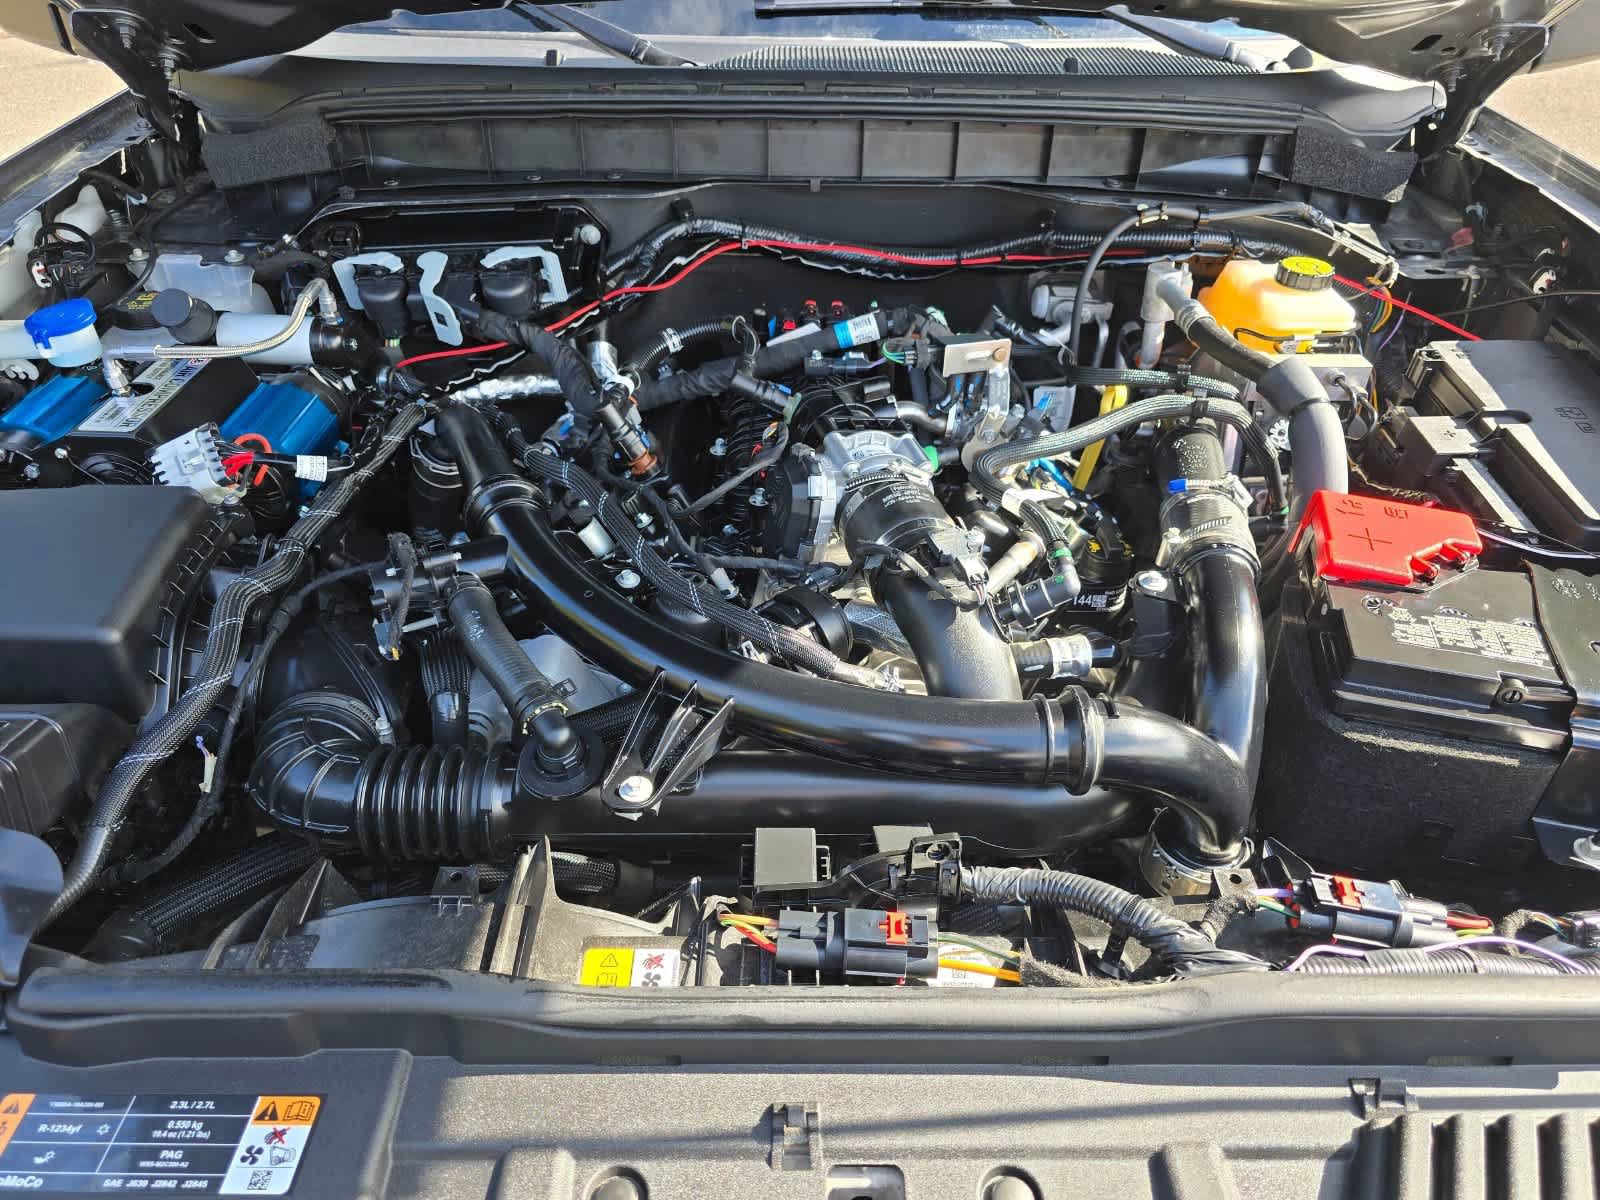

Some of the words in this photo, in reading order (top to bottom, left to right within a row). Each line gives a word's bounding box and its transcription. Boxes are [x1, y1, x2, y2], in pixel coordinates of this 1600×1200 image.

[170, 1101, 190, 1109] 2.3L
[196, 1101, 215, 1109] 2.7L
[38, 1124, 83, 1135] R-1234yf
[192, 1120, 203, 1130] kg
[160, 1150, 184, 1159] PAG
[103, 1179, 124, 1187] SAE
